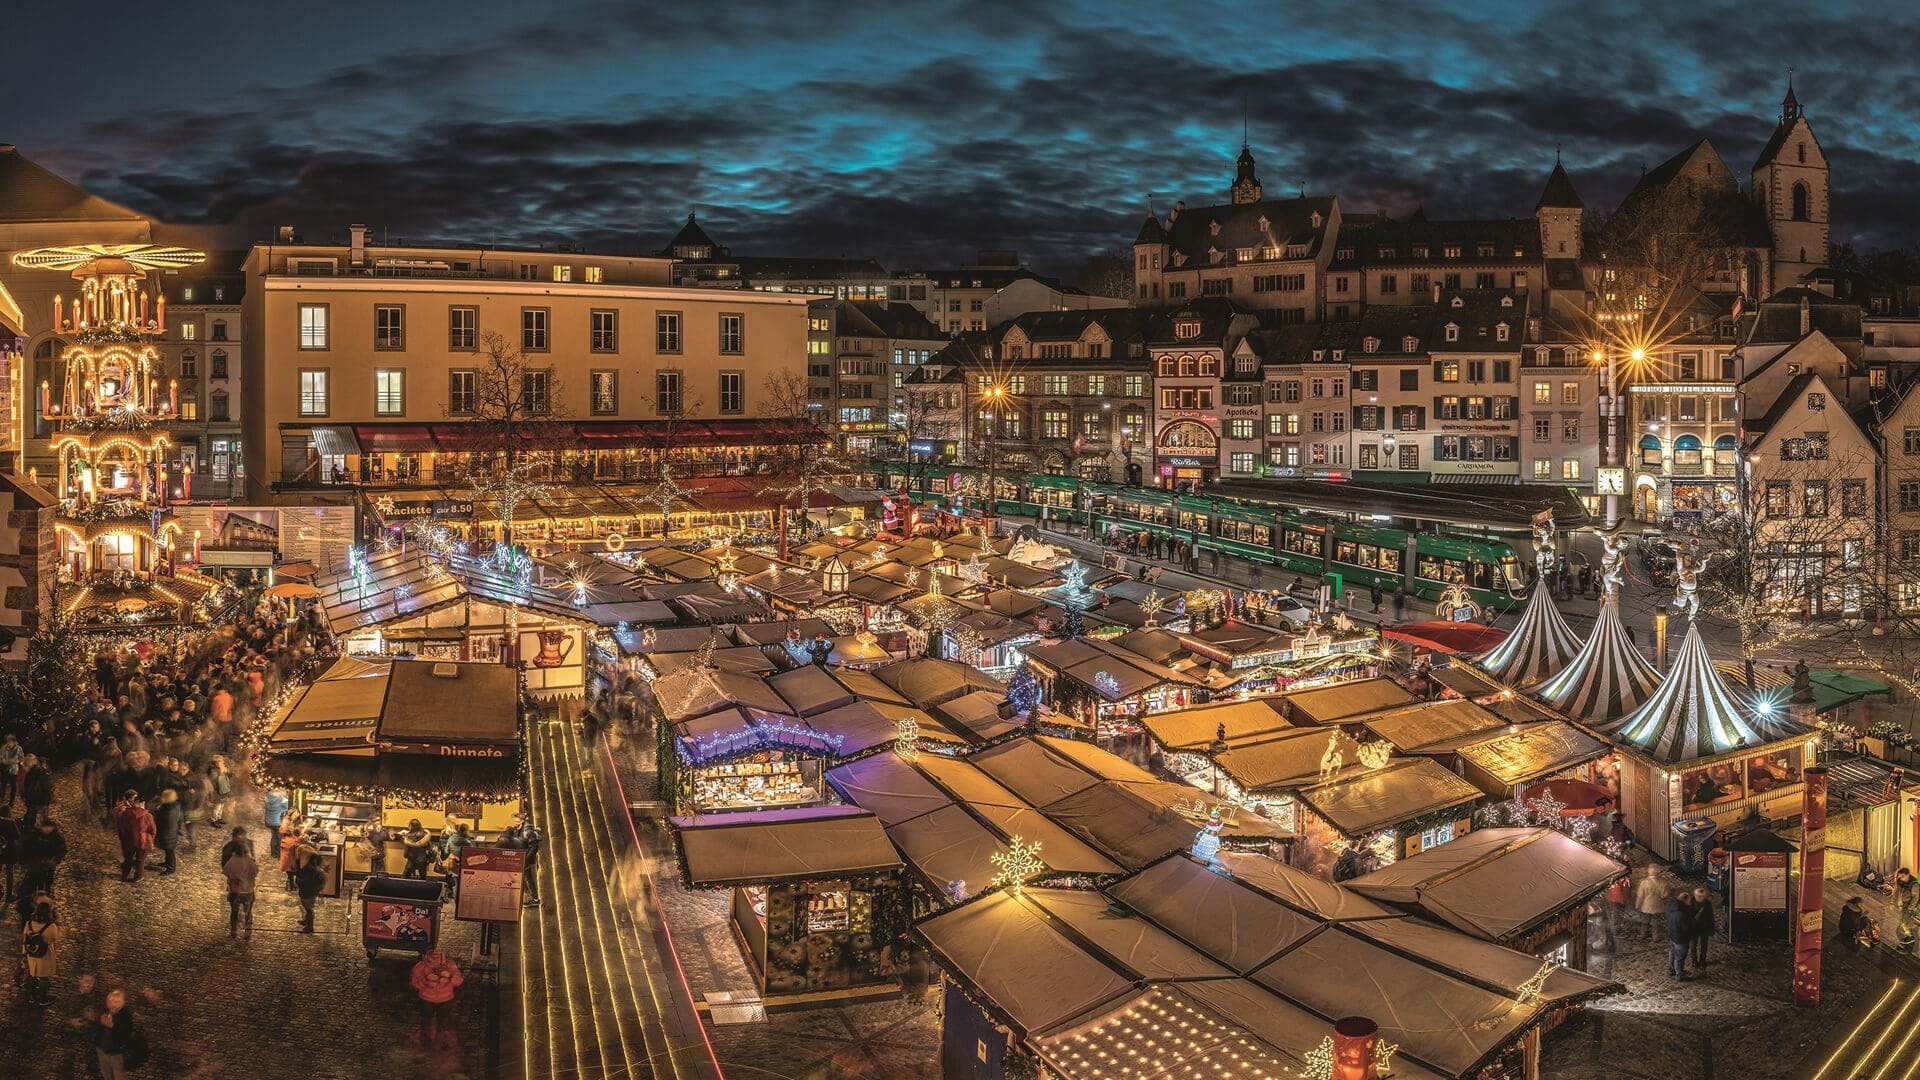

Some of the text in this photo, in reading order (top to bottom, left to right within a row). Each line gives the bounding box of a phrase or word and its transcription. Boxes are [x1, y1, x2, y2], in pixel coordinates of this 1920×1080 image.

[1226, 408, 1258, 417] Apotheke
[386, 506, 432, 516] Raclette
[450, 504, 472, 513] 8.50
